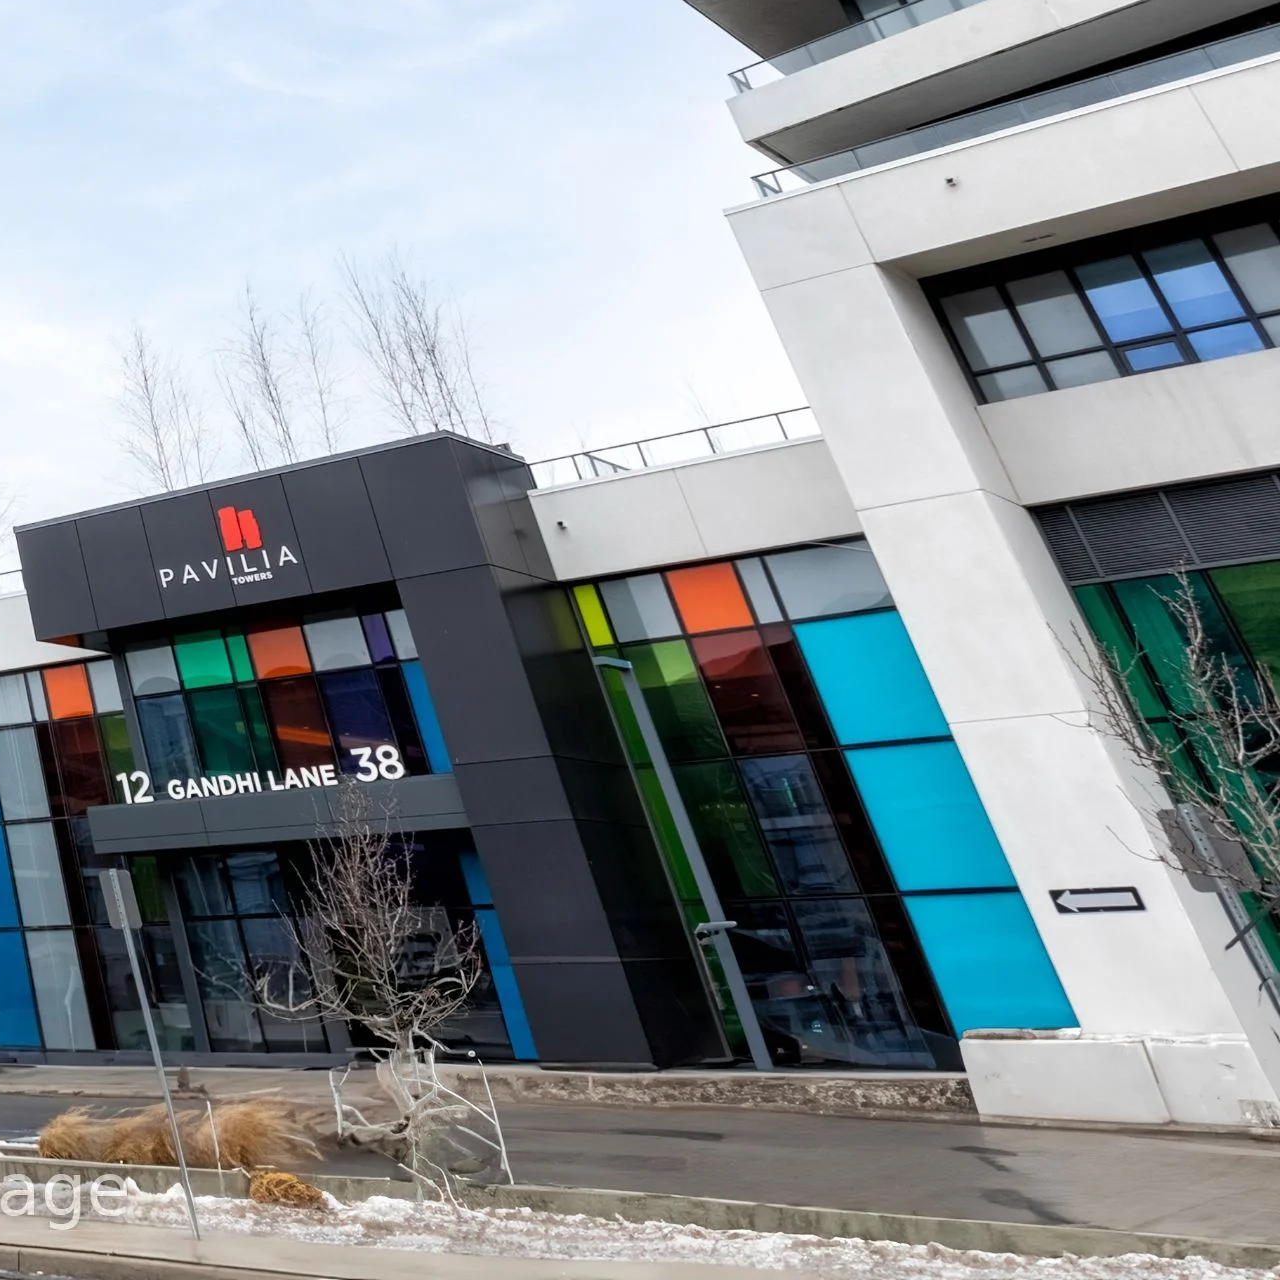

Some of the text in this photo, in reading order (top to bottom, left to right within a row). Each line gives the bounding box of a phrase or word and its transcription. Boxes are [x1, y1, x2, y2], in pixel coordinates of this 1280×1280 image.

[159, 545, 298, 588] PAVILIA
[231, 571, 273, 585] TOWERS
[115, 745, 405, 805] 12 GANDHI LANE 38
